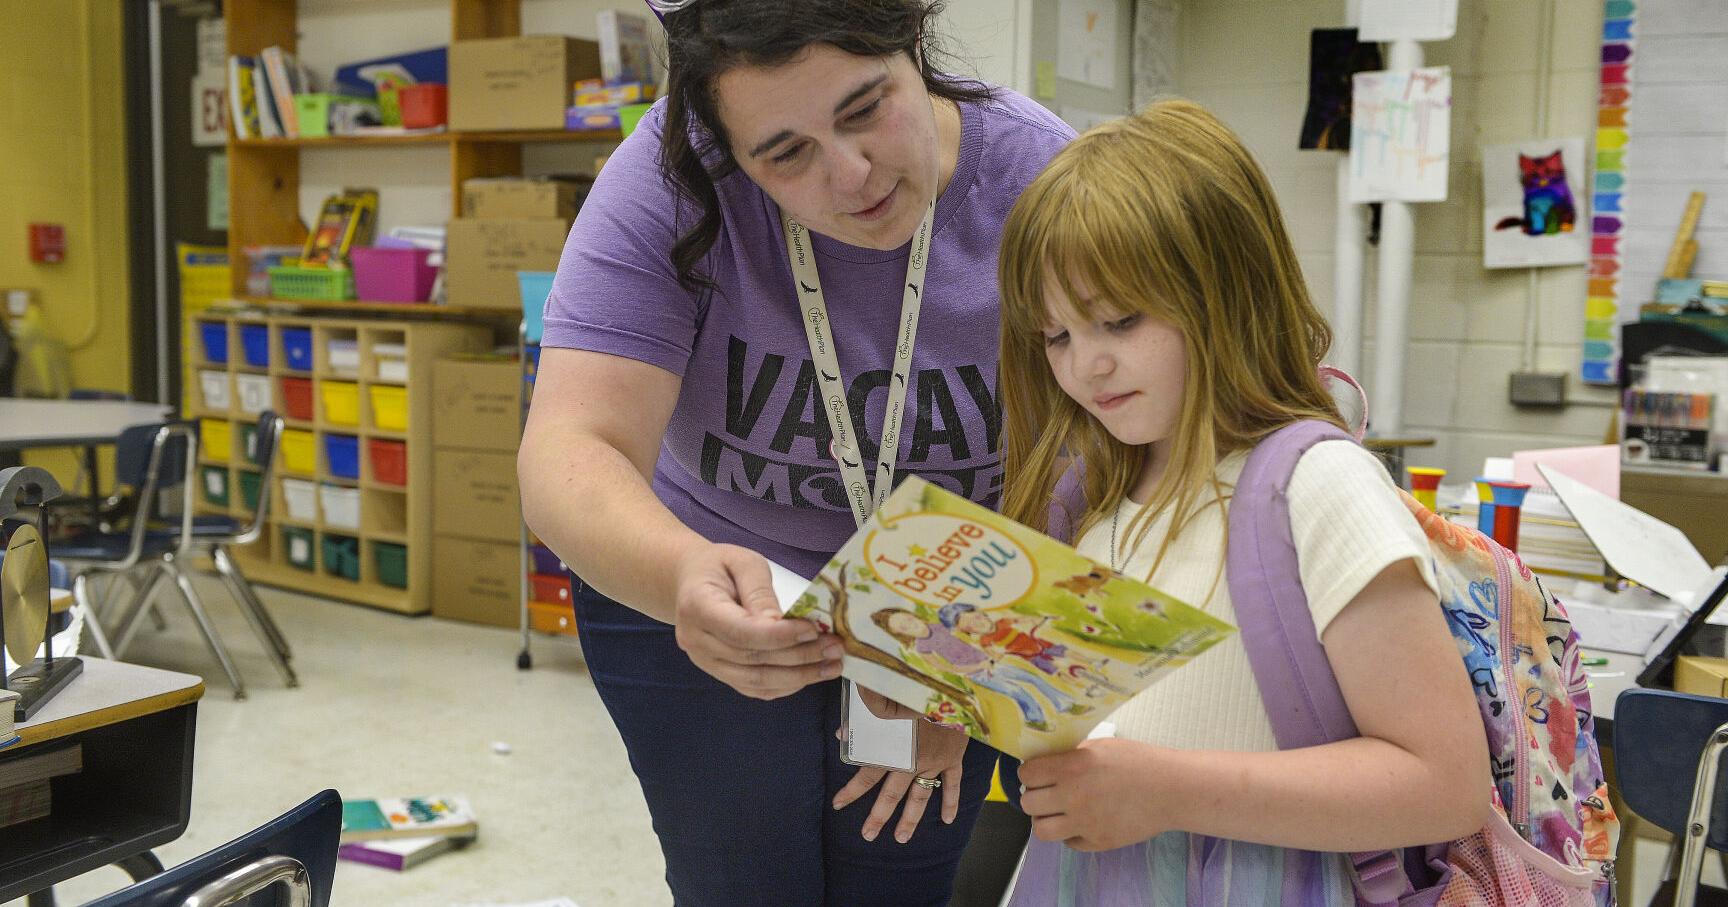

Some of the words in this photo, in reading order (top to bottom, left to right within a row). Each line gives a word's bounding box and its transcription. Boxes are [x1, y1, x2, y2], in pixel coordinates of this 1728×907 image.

[726, 334, 1004, 463] VACAY
[876, 553, 908, 571] I
[894, 523, 984, 592] believe
[933, 585, 964, 602] in
[950, 540, 1017, 600] you
